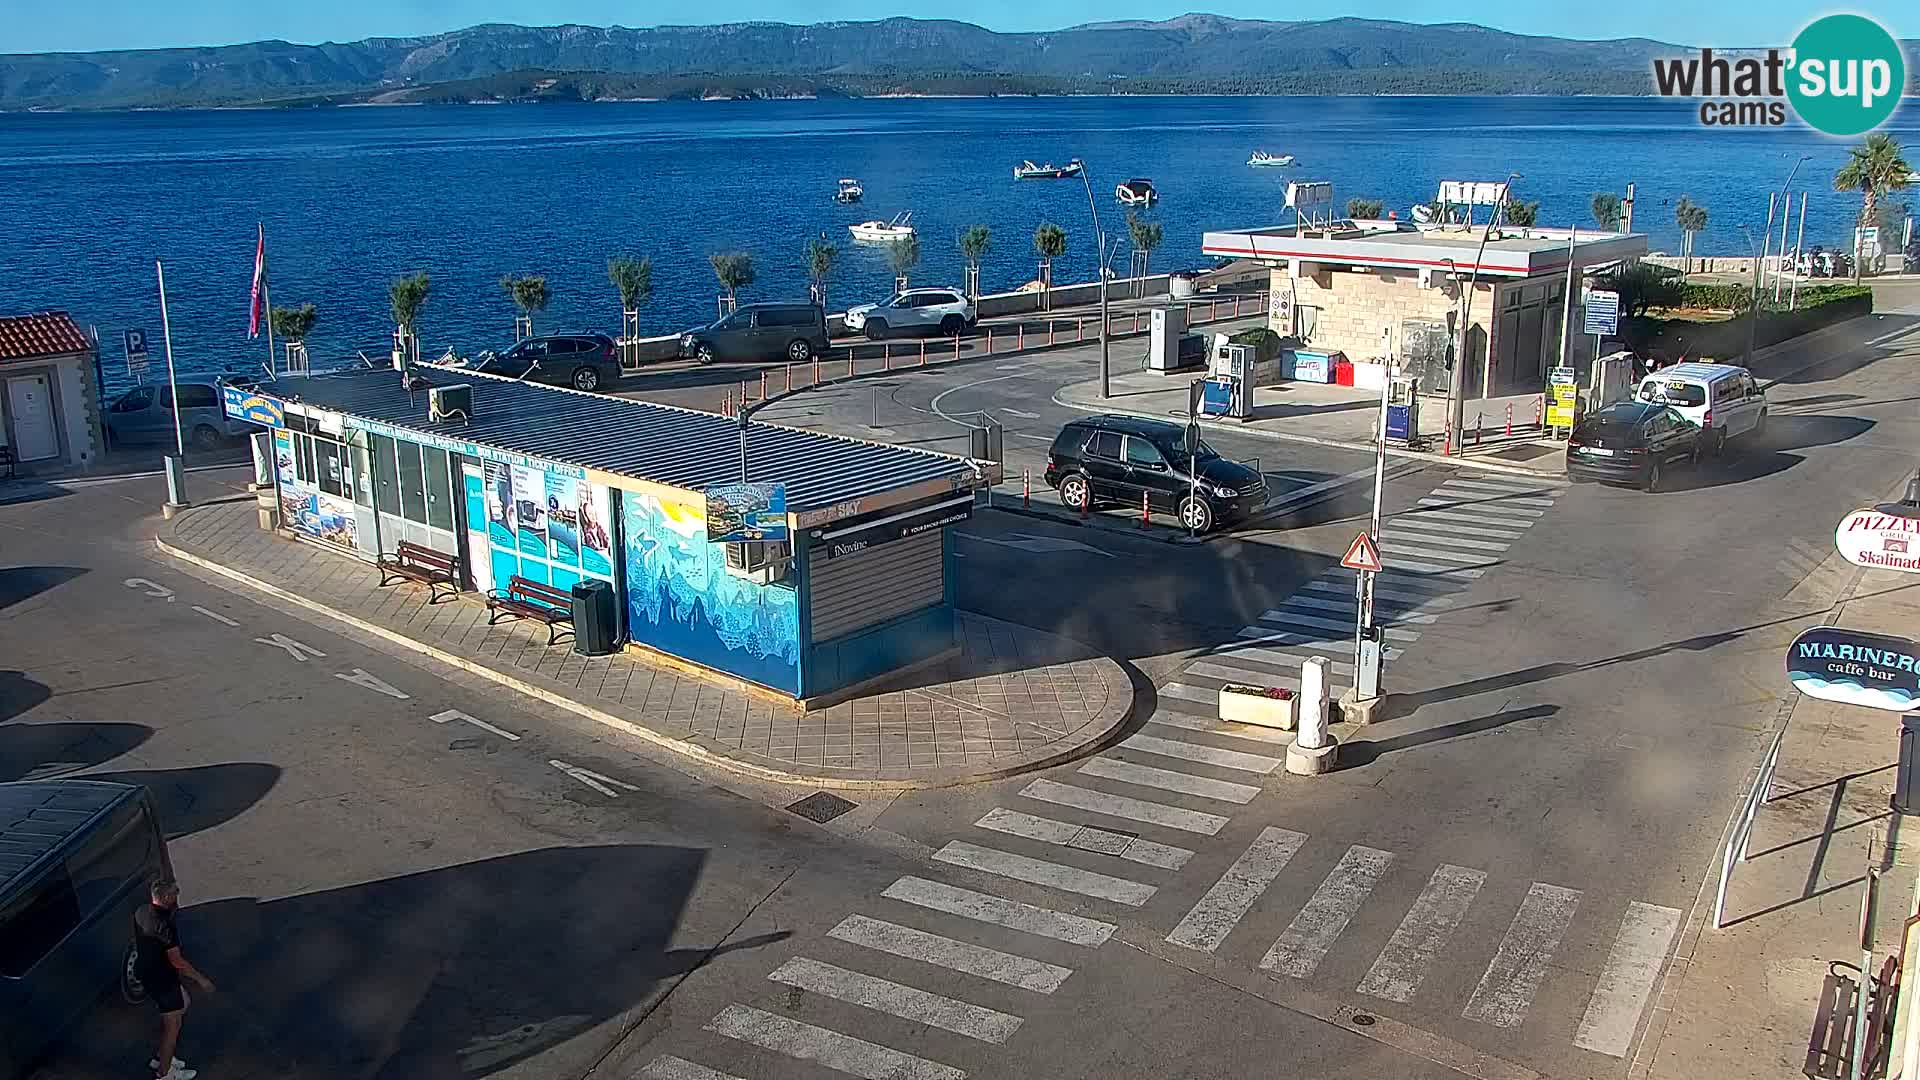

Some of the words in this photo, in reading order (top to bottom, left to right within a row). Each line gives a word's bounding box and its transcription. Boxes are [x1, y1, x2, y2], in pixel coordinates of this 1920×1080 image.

[493, 450, 525, 466] STATION
[527, 456, 553, 473] TICKET
[553, 462, 583, 479] OFFICE
[949, 513, 967, 523] CHOICE
[1827, 662, 1865, 676] caffe
[1868, 666, 1896, 681] bar
